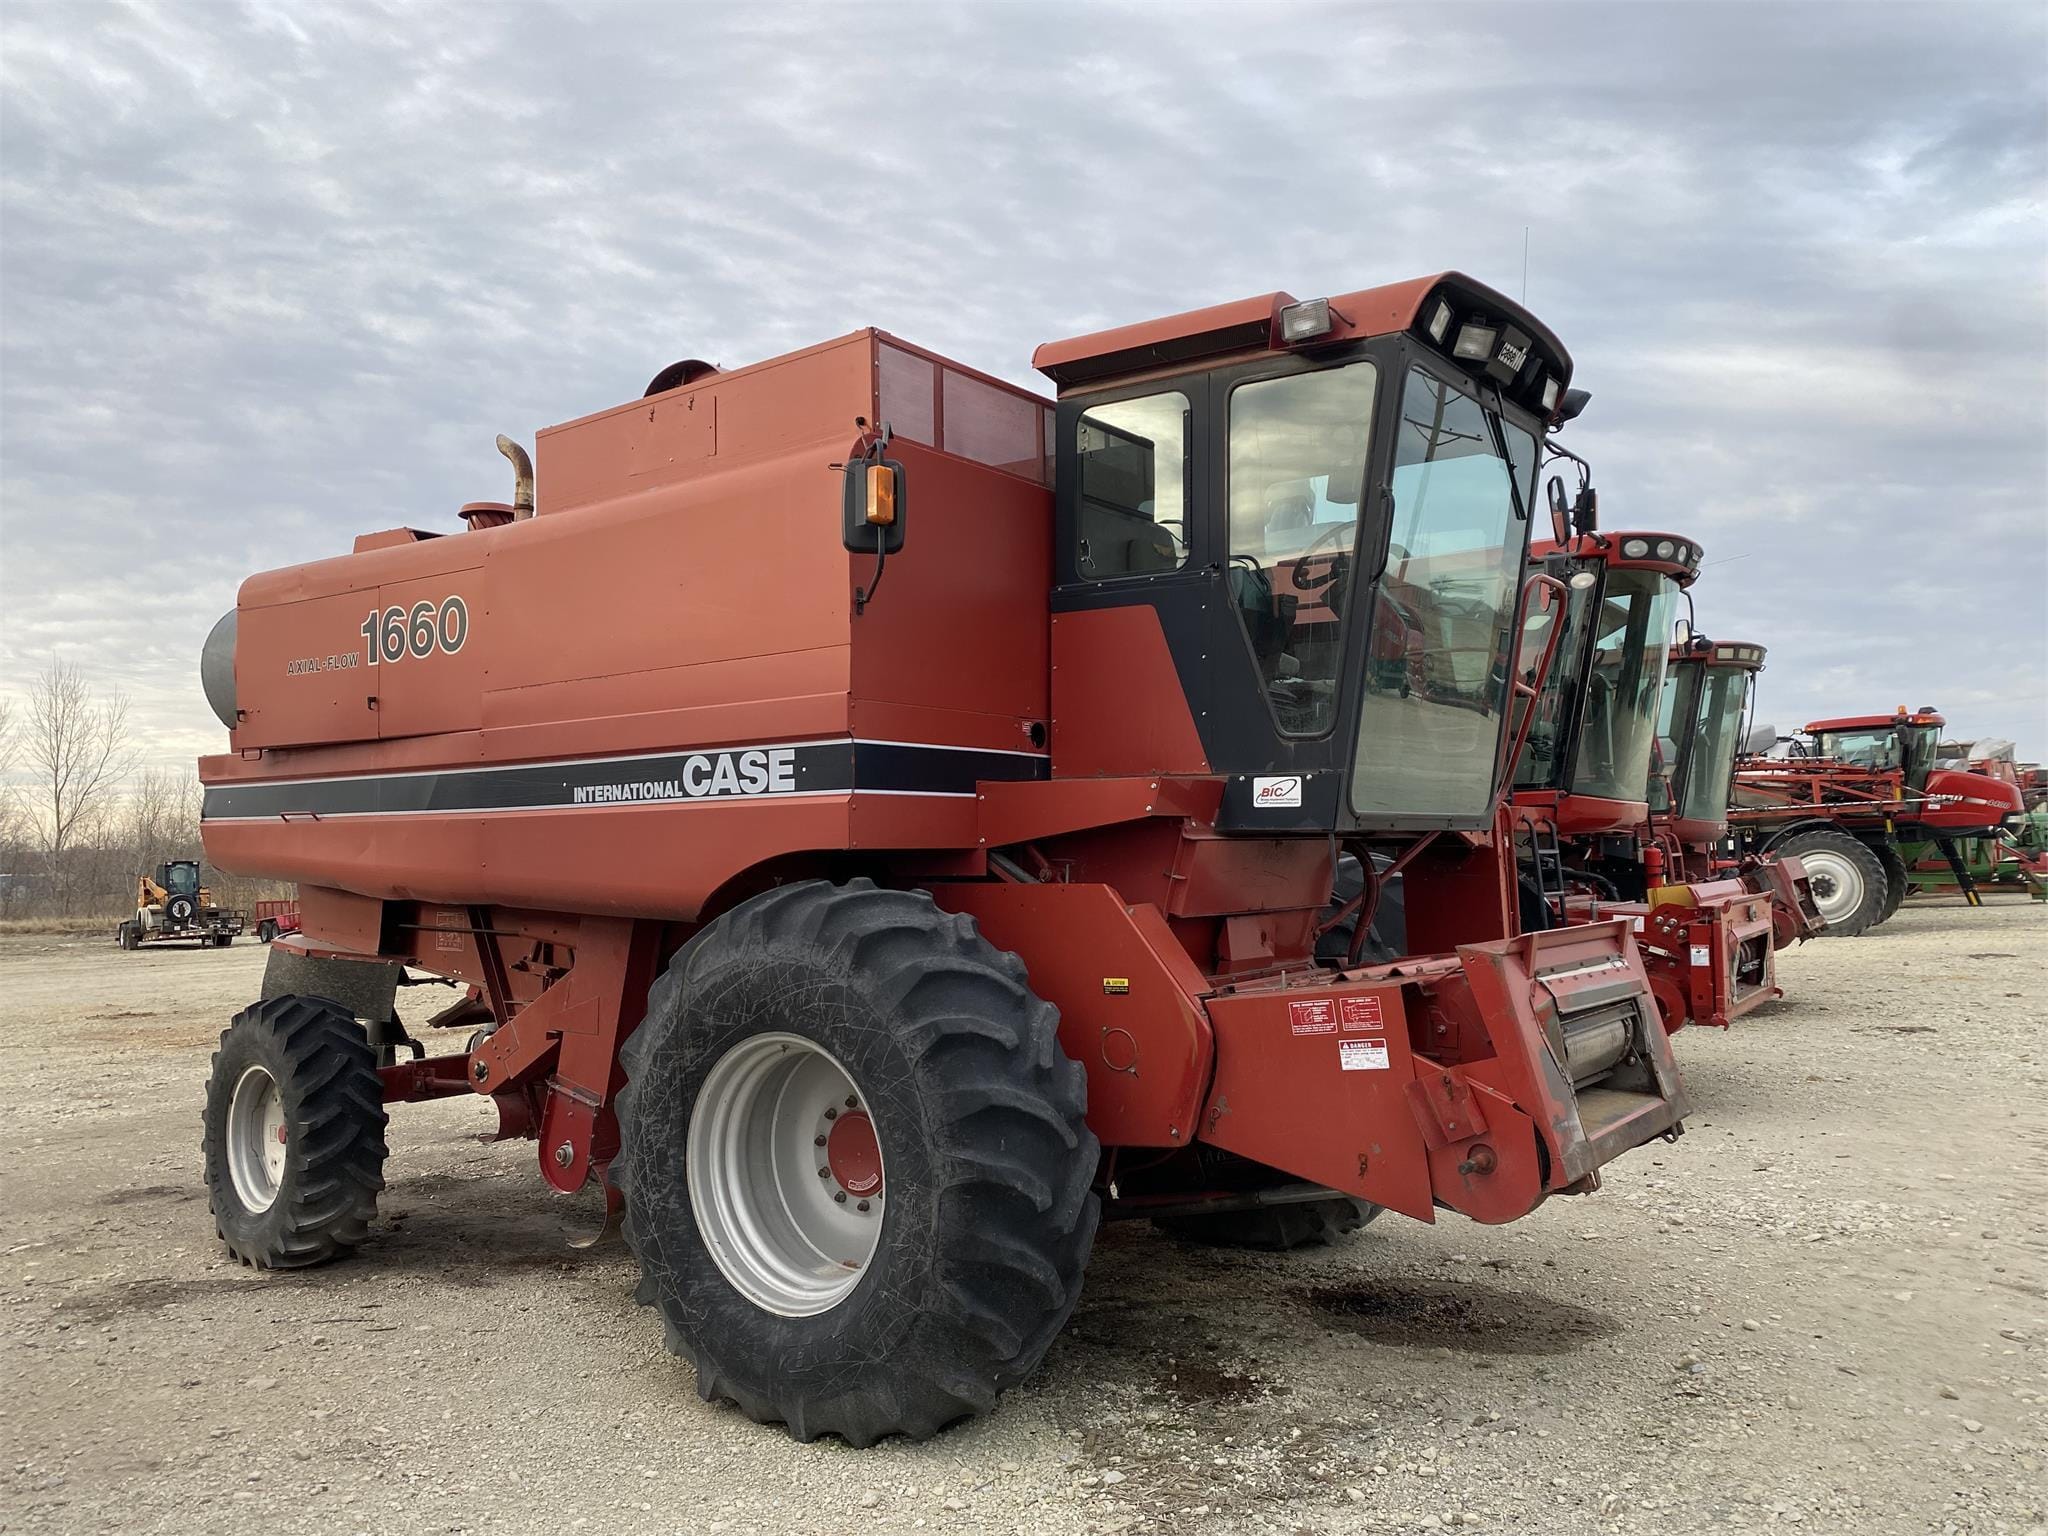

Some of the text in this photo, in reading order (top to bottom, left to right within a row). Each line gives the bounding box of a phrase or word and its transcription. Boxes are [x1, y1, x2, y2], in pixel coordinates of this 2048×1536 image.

[361, 595, 469, 666] 1660
[287, 652, 360, 676] AXIAL-FLOW
[573, 749, 795, 803] INTERNATIONAL CASE
[1261, 787, 1284, 798] BIC
